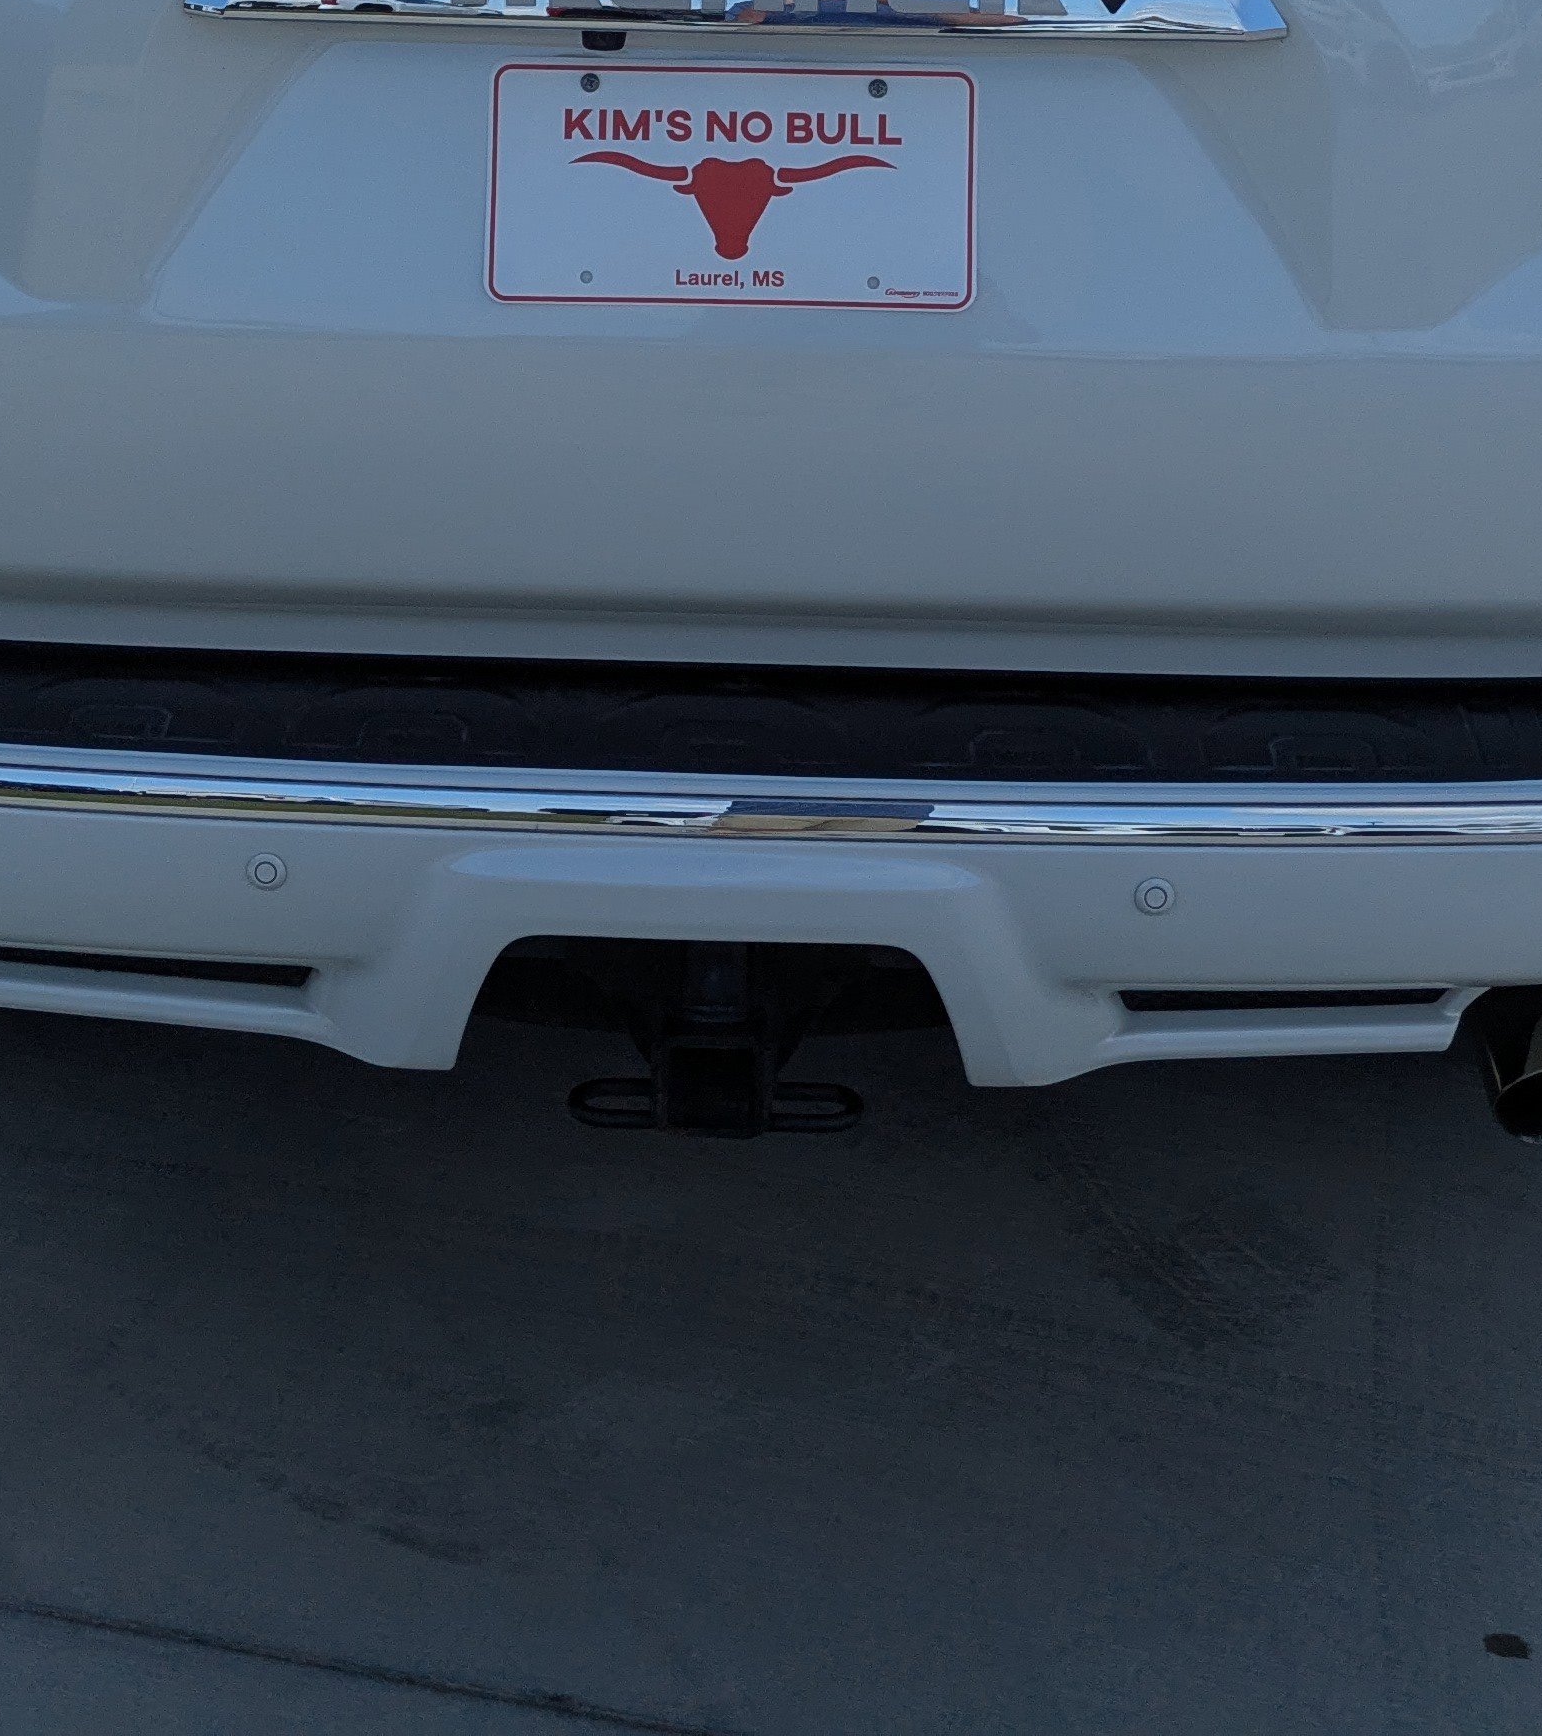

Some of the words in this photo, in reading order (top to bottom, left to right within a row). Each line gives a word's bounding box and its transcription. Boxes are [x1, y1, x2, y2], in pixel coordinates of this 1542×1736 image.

[563, 108, 693, 142] KIM'S
[705, 110, 773, 143] NO
[786, 112, 903, 145] BULL
[675, 269, 745, 289] Laurel,
[752, 270, 785, 287] MS
